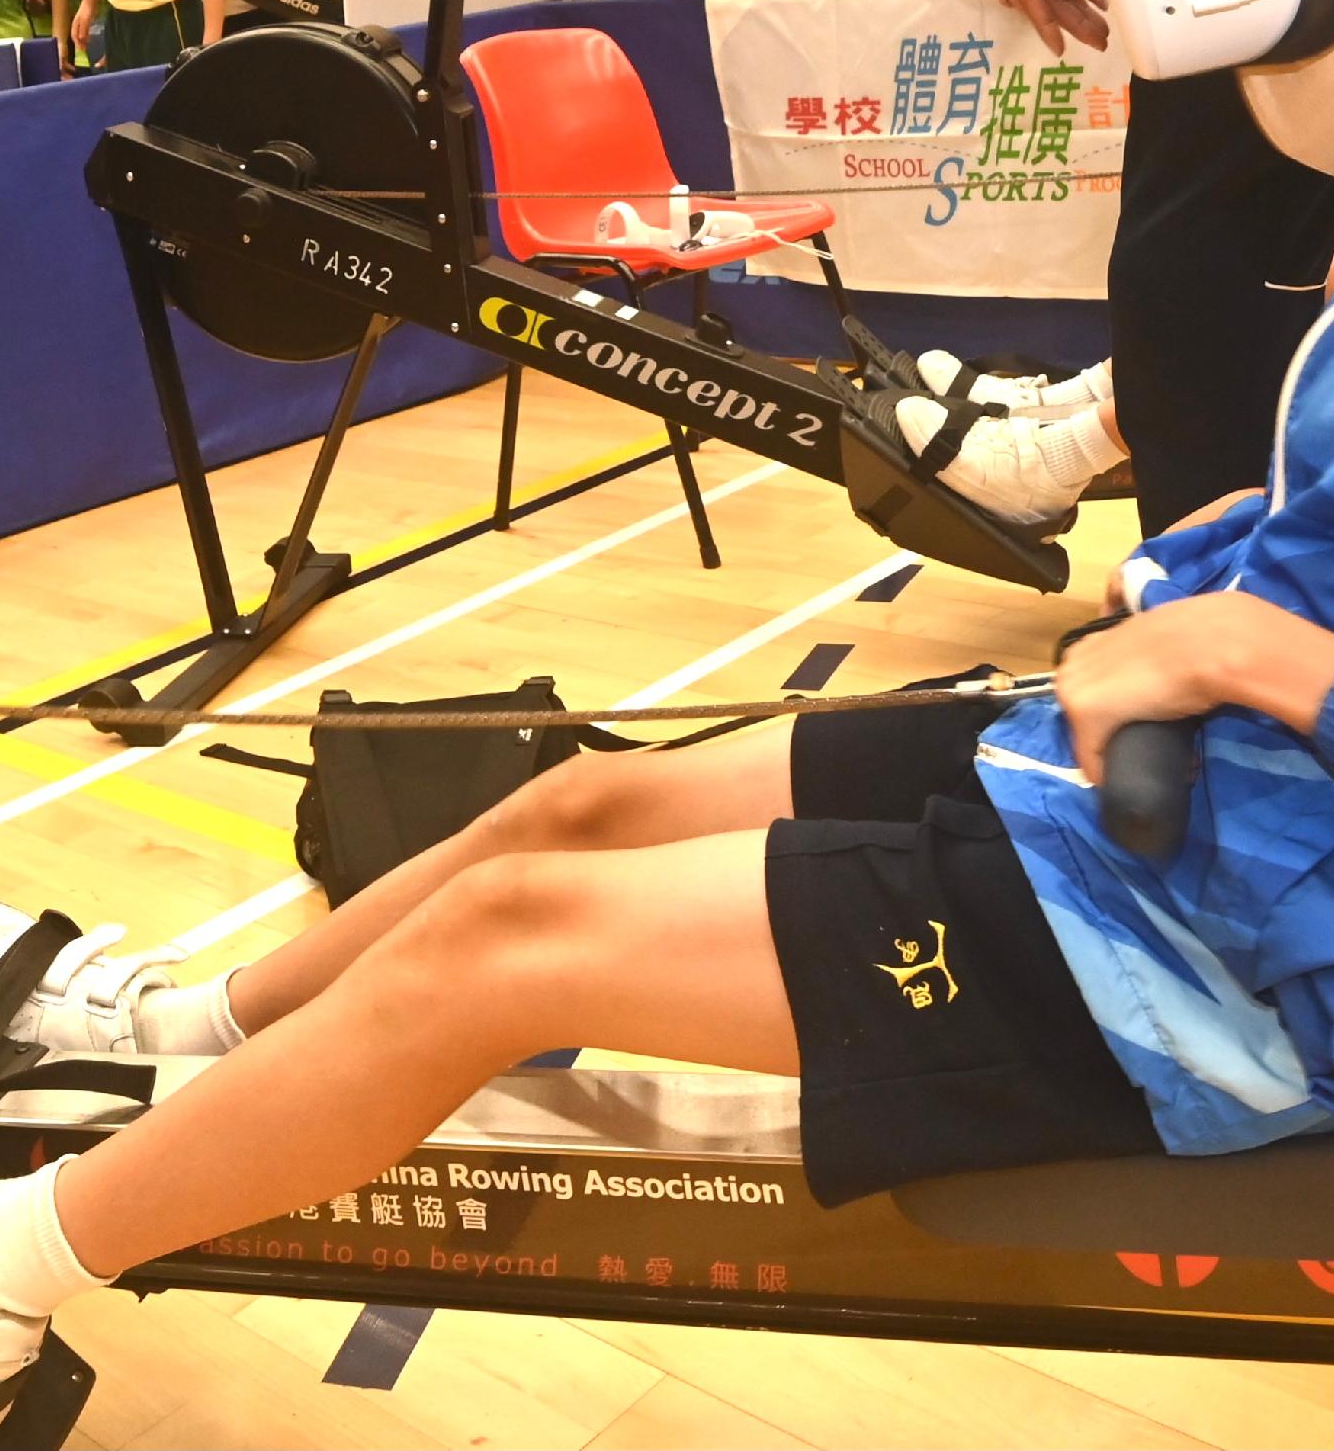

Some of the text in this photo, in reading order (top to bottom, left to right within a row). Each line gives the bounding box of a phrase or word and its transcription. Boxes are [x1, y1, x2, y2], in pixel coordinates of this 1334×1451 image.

[845, 154, 1122, 226] SCHOOL SPORTS PRO
[555, 329, 823, 447] concept 2
[448, 1163, 573, 1200] Rowing
[584, 1169, 785, 1205] Association
[322, 1239, 353, 1263] to
[372, 1247, 411, 1272] go
[430, 1245, 559, 1278] beyond
